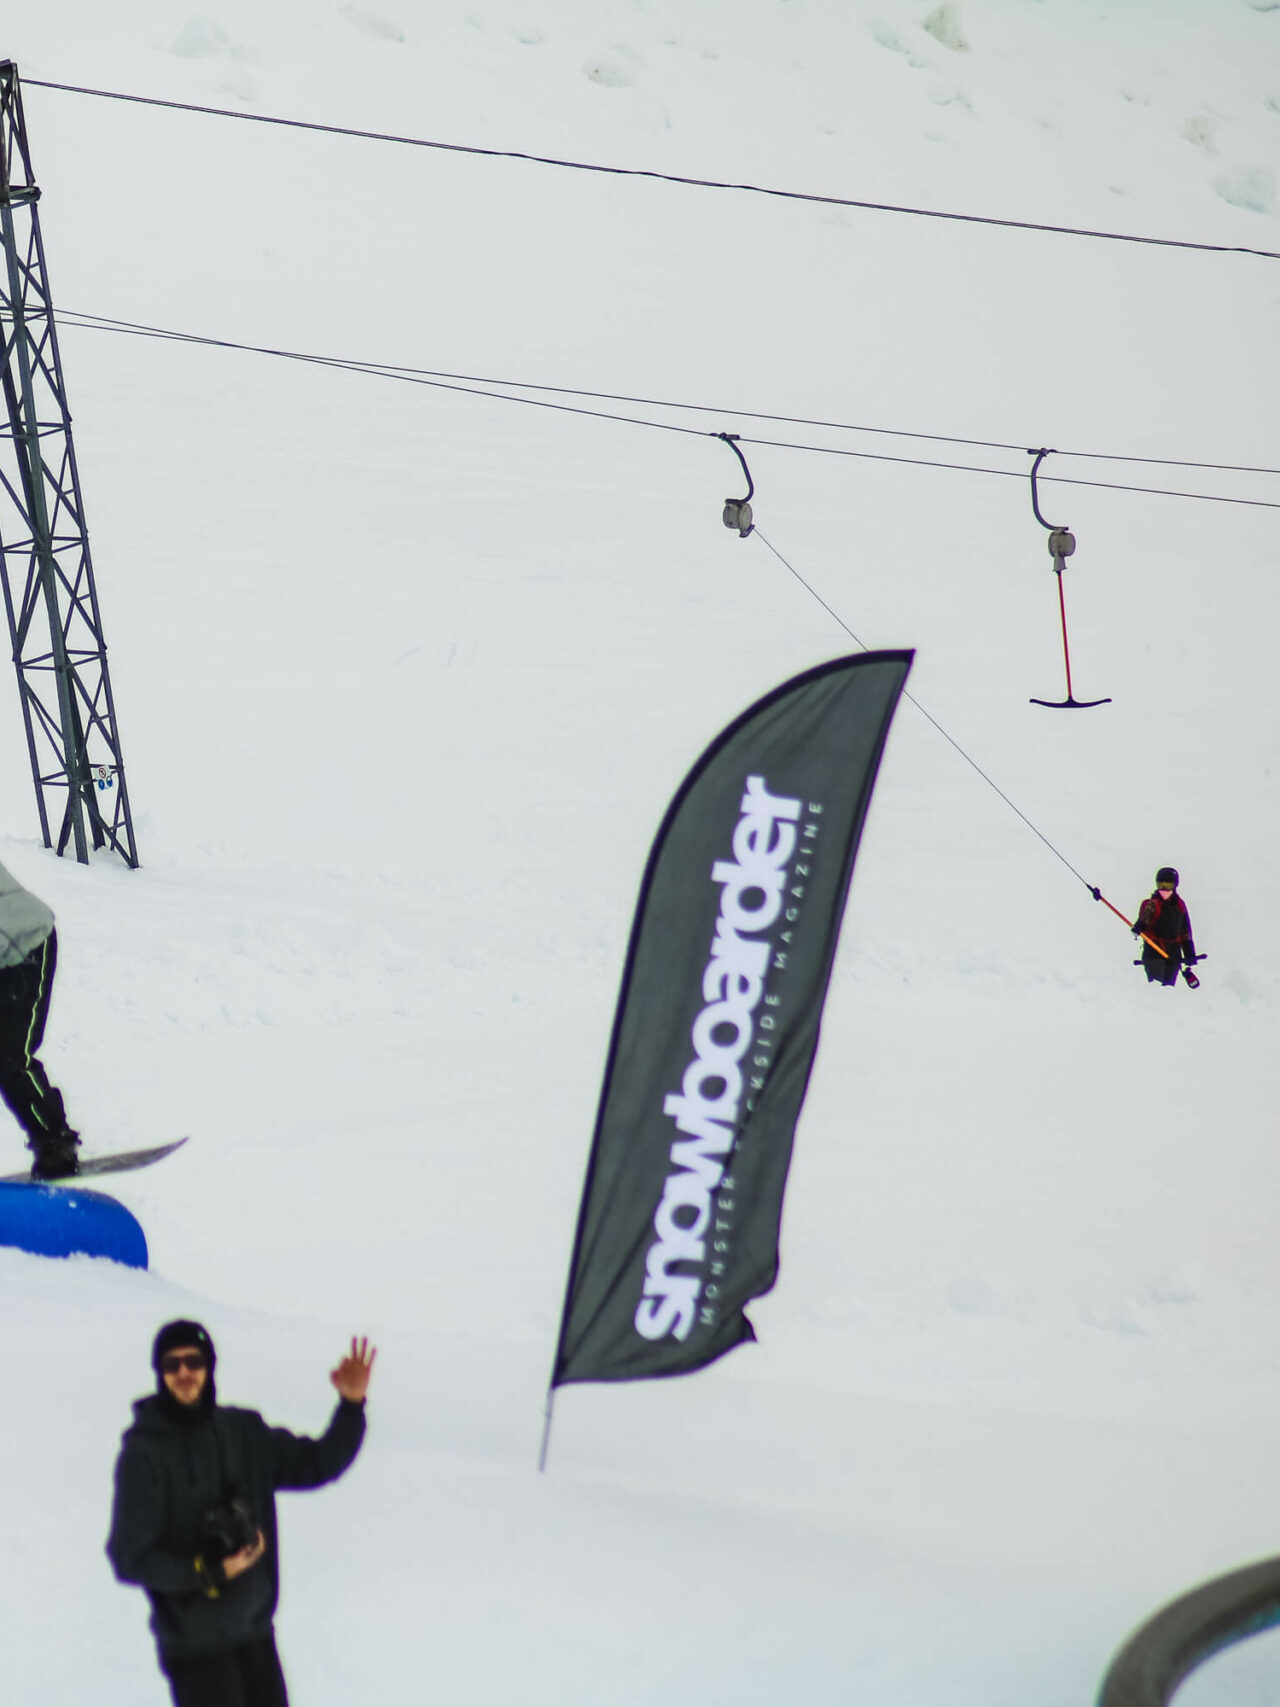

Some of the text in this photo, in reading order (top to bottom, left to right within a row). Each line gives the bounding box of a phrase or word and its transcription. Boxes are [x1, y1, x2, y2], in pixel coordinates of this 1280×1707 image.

[635, 776, 802, 1342] snowboarder
[699, 1176, 736, 1325] MONSTER
[773, 801, 823, 969] MAGAZINE
